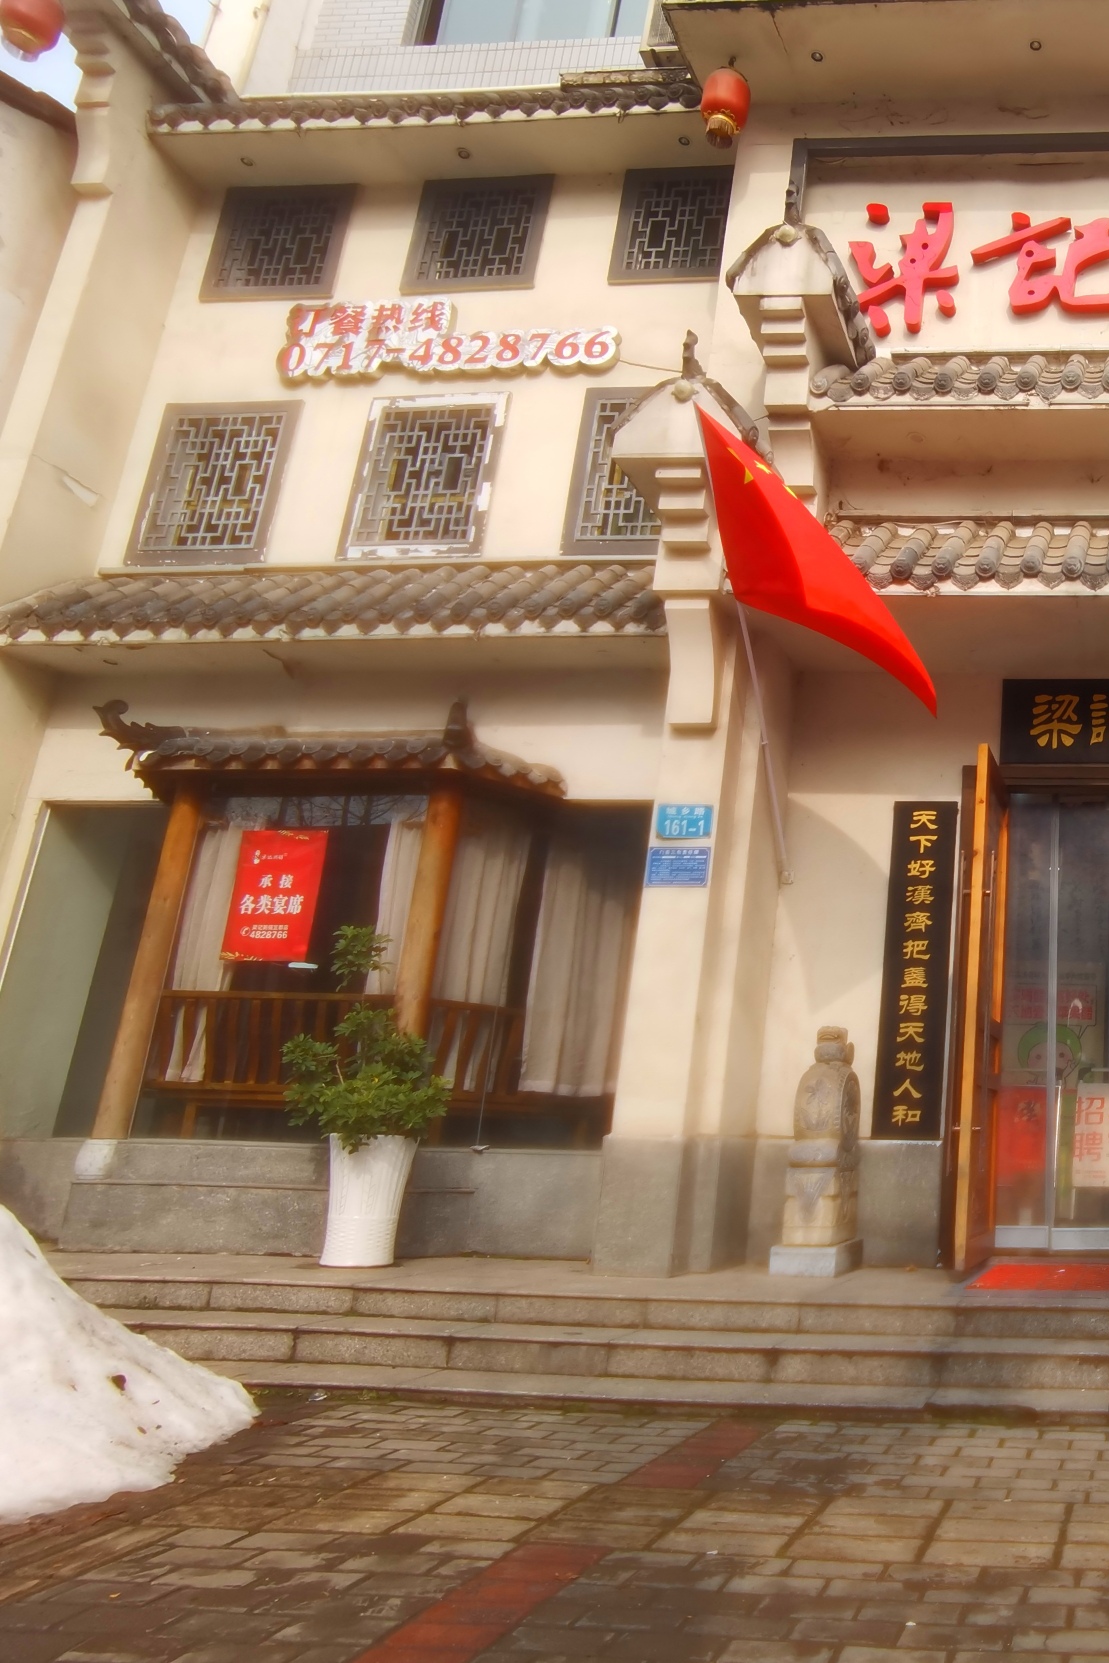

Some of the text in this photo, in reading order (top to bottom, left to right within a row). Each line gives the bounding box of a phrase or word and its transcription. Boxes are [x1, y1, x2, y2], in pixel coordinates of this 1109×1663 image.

[292, 301, 448, 338] 订餐热线
[280, 331, 610, 374] 0717-4828766
[664, 819, 705, 836] 161-1
[258, 874, 294, 889] 承接
[240, 895, 304, 915] 各类宴席
[249, 930, 288, 939] 4828766
[1074, 1097, 1105, 1161] 招聘
